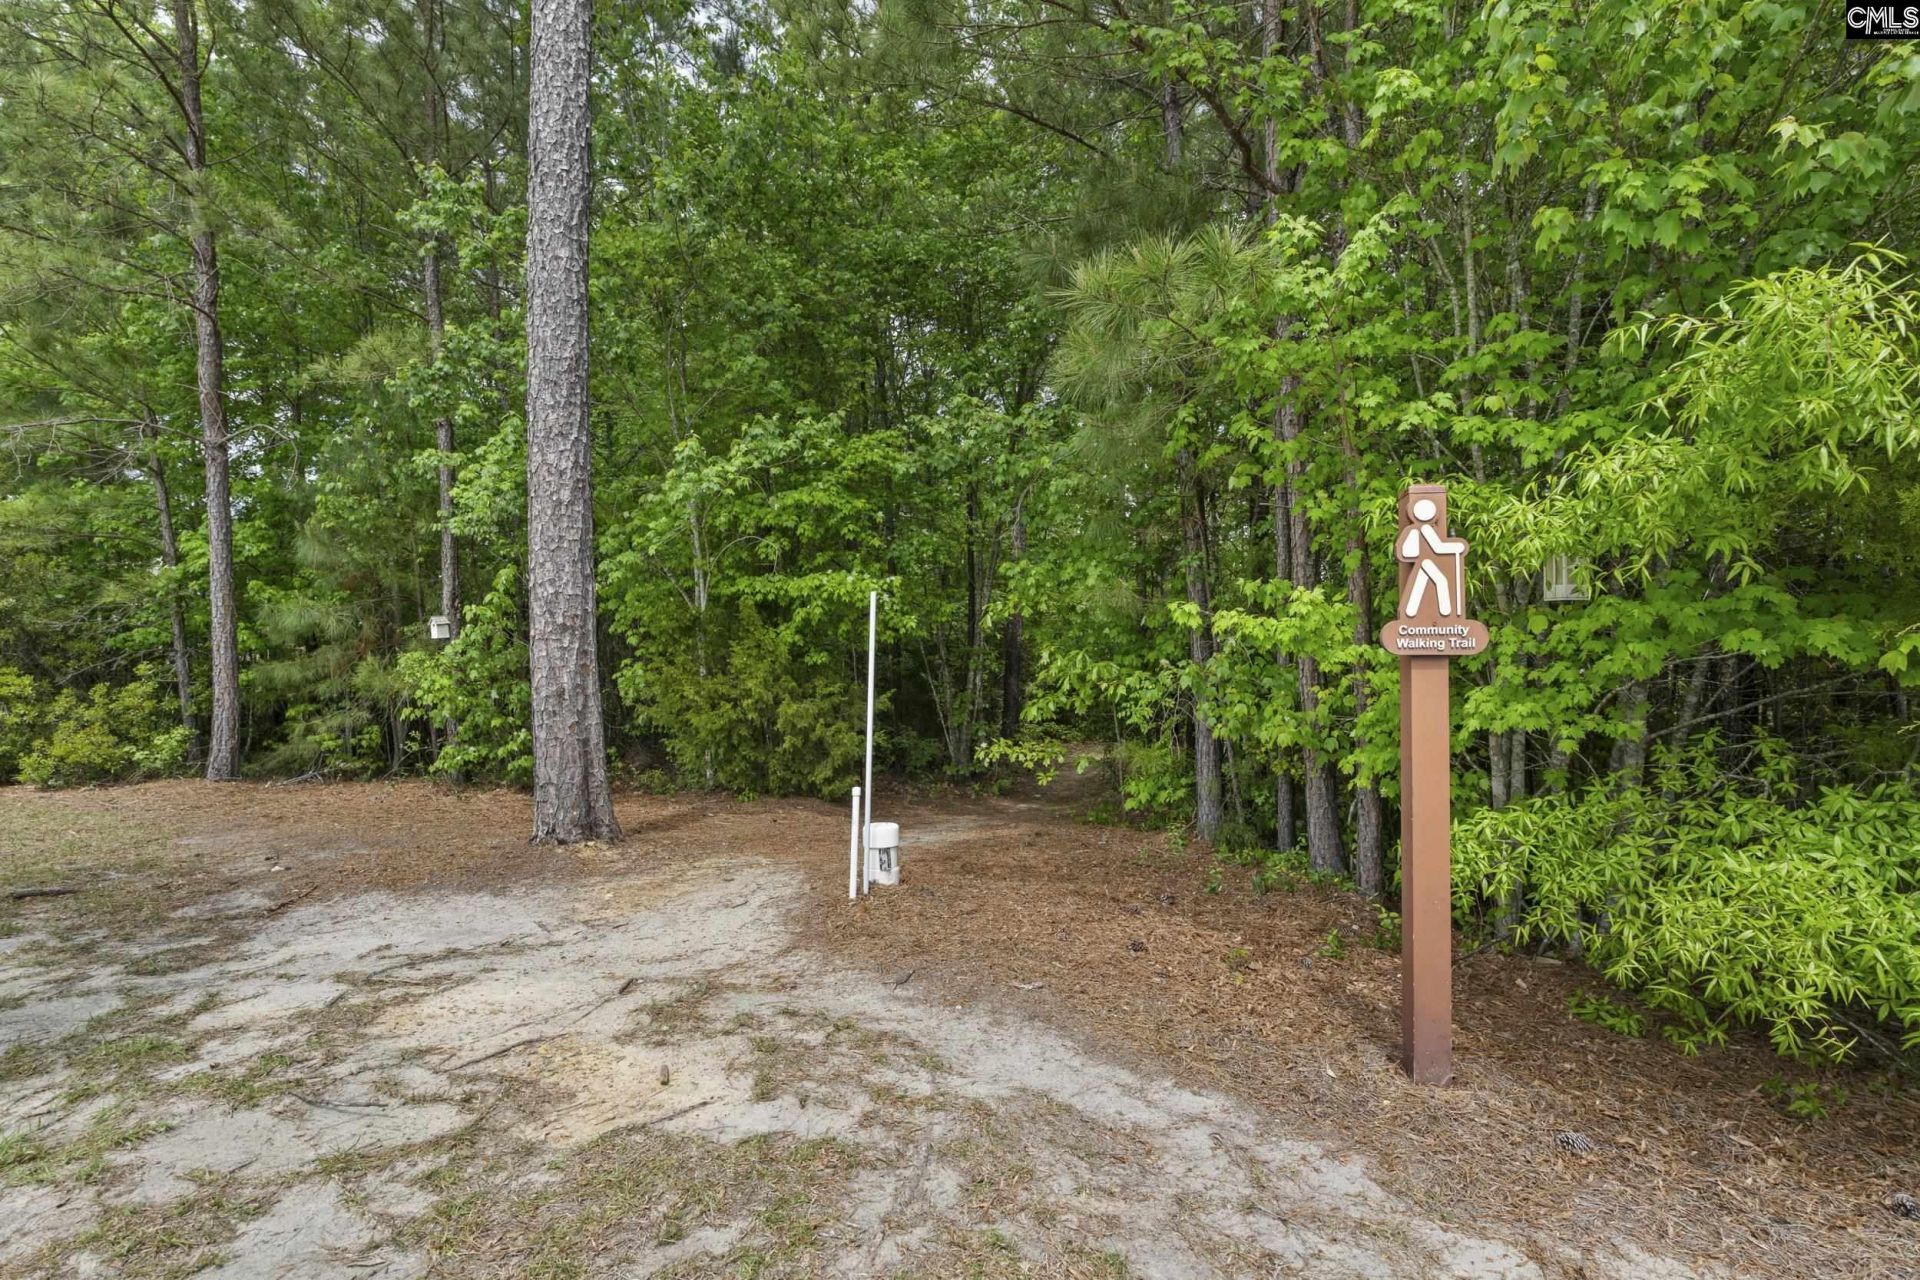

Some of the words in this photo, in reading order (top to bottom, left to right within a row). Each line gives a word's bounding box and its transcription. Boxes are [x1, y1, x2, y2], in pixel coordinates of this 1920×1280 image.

[1398, 625, 1469, 636] Community
[1396, 638, 1445, 650] Walking
[1449, 637, 1476, 648] Trail
